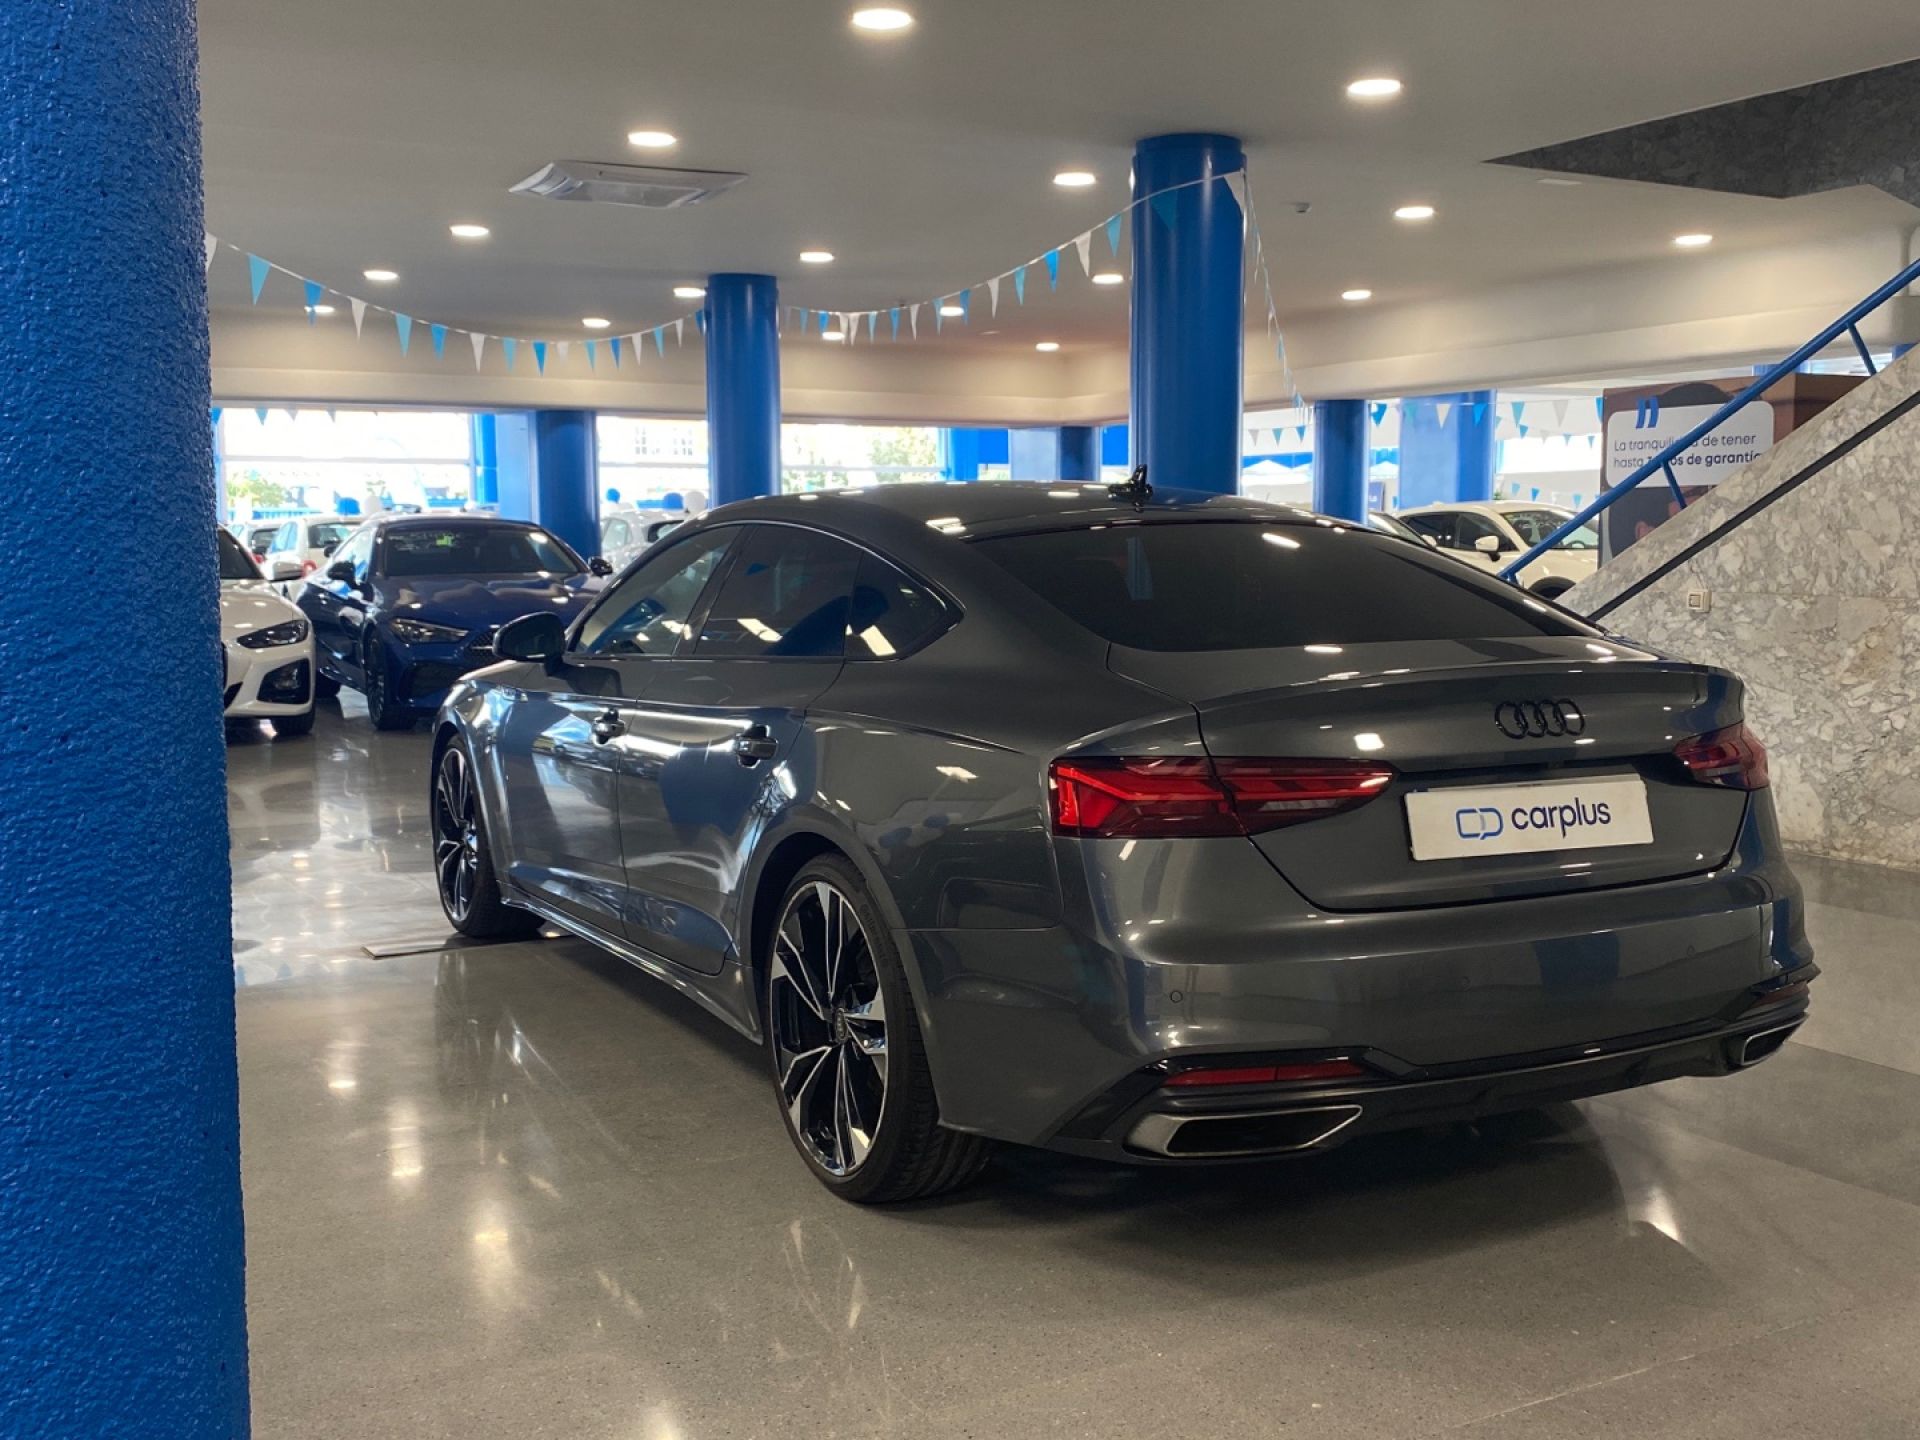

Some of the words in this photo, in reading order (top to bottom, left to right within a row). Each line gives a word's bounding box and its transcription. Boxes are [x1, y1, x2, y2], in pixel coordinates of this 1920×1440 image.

[1614, 439, 1626, 452] La
[1702, 434, 1718, 447] de
[1721, 434, 1756, 447] tener
[1613, 456, 1644, 468] hasta
[1686, 453, 1702, 465] de
[1511, 797, 1611, 838] carplus
